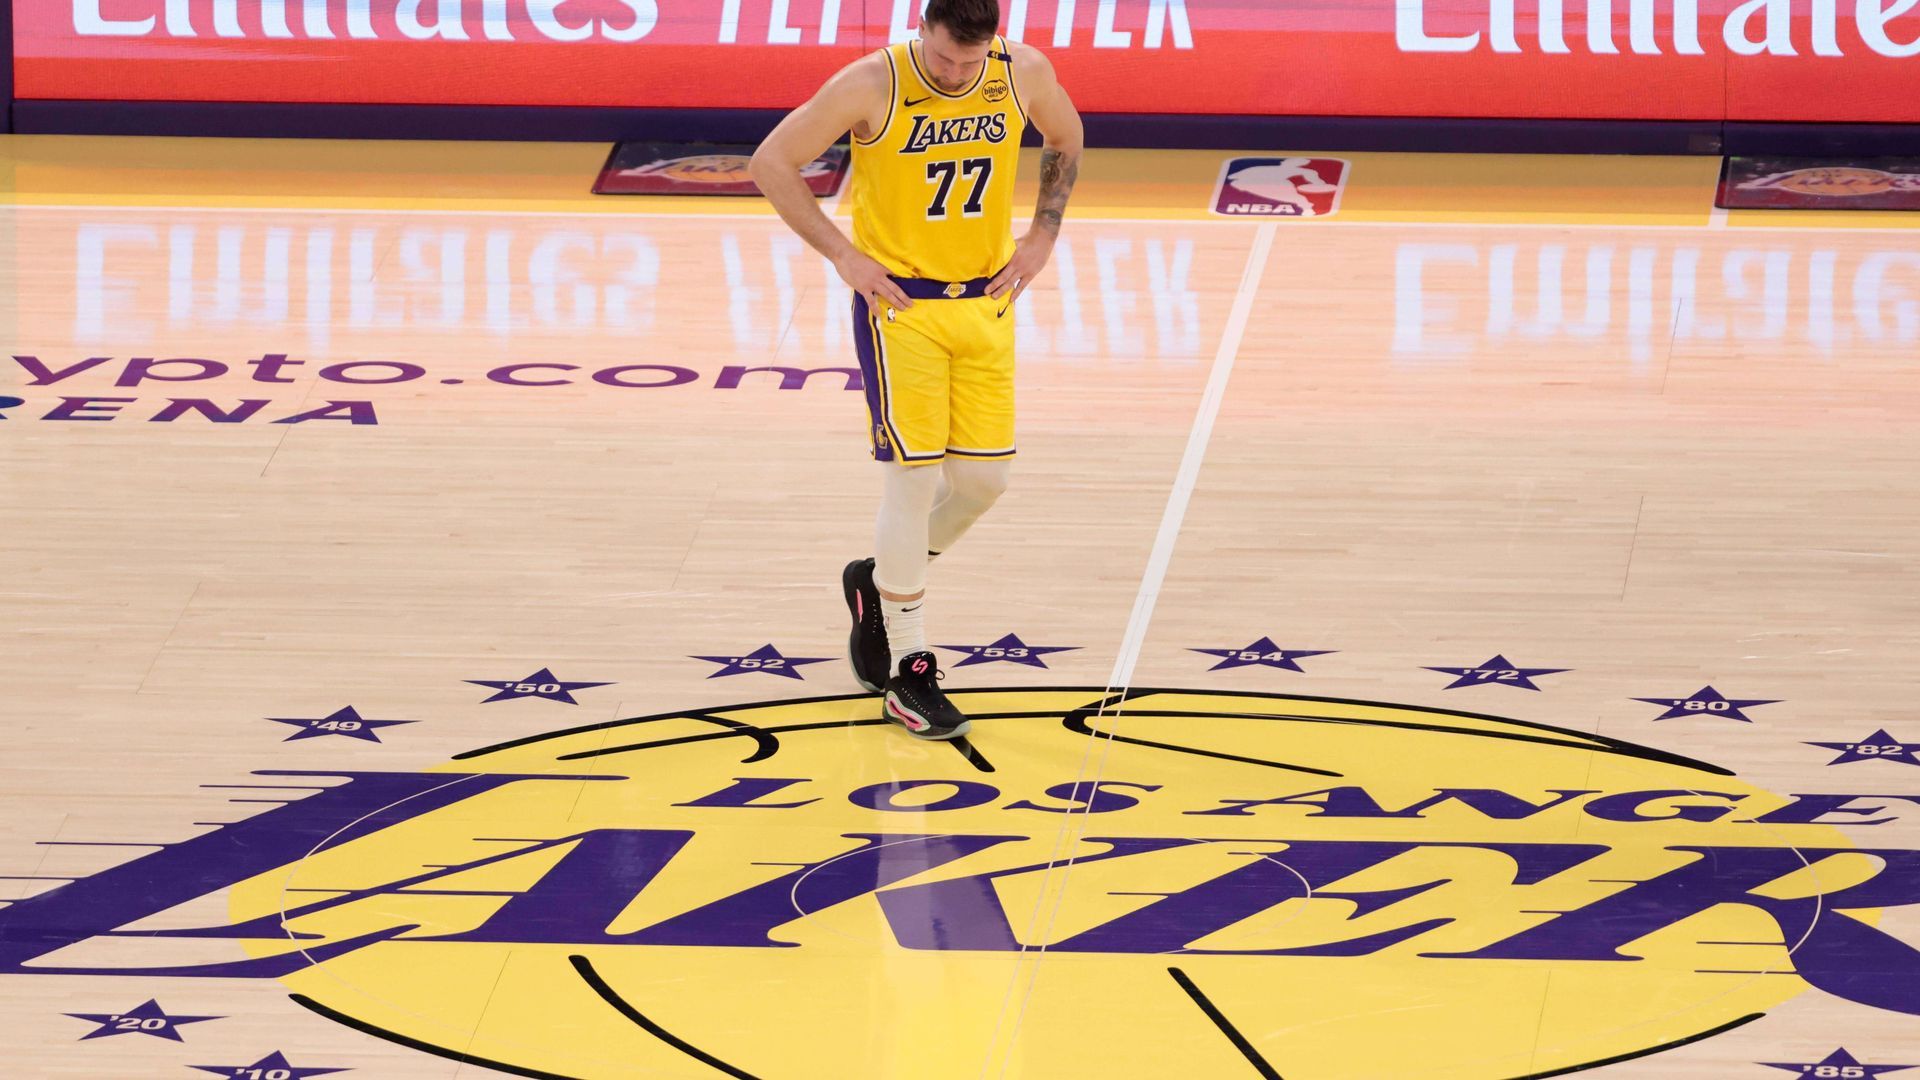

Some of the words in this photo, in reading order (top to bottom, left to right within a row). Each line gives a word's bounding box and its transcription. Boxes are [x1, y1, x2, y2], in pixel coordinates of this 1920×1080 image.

[984, 85, 1007, 95] bibigo
[898, 113, 1007, 153] LAKERS
[926, 157, 993, 221] 77
[1226, 203, 1296, 213] NBA
[12, 354, 864, 391] ypto.com
[0, 396, 379, 425] ENA
[973, 647, 1030, 659] '53
[1228, 650, 1285, 662] '54
[729, 658, 785, 669] '52
[1463, 669, 1520, 680] '72
[504, 682, 561, 693] '50
[1673, 700, 1731, 711] '80
[310, 720, 362, 731] '49
[1846, 744, 1903, 755] '82
[671, 777, 1164, 814] LOS
[110, 1015, 167, 1030] '20
[235, 1068, 292, 1080] '10
[1803, 1065, 1865, 1078] '85
